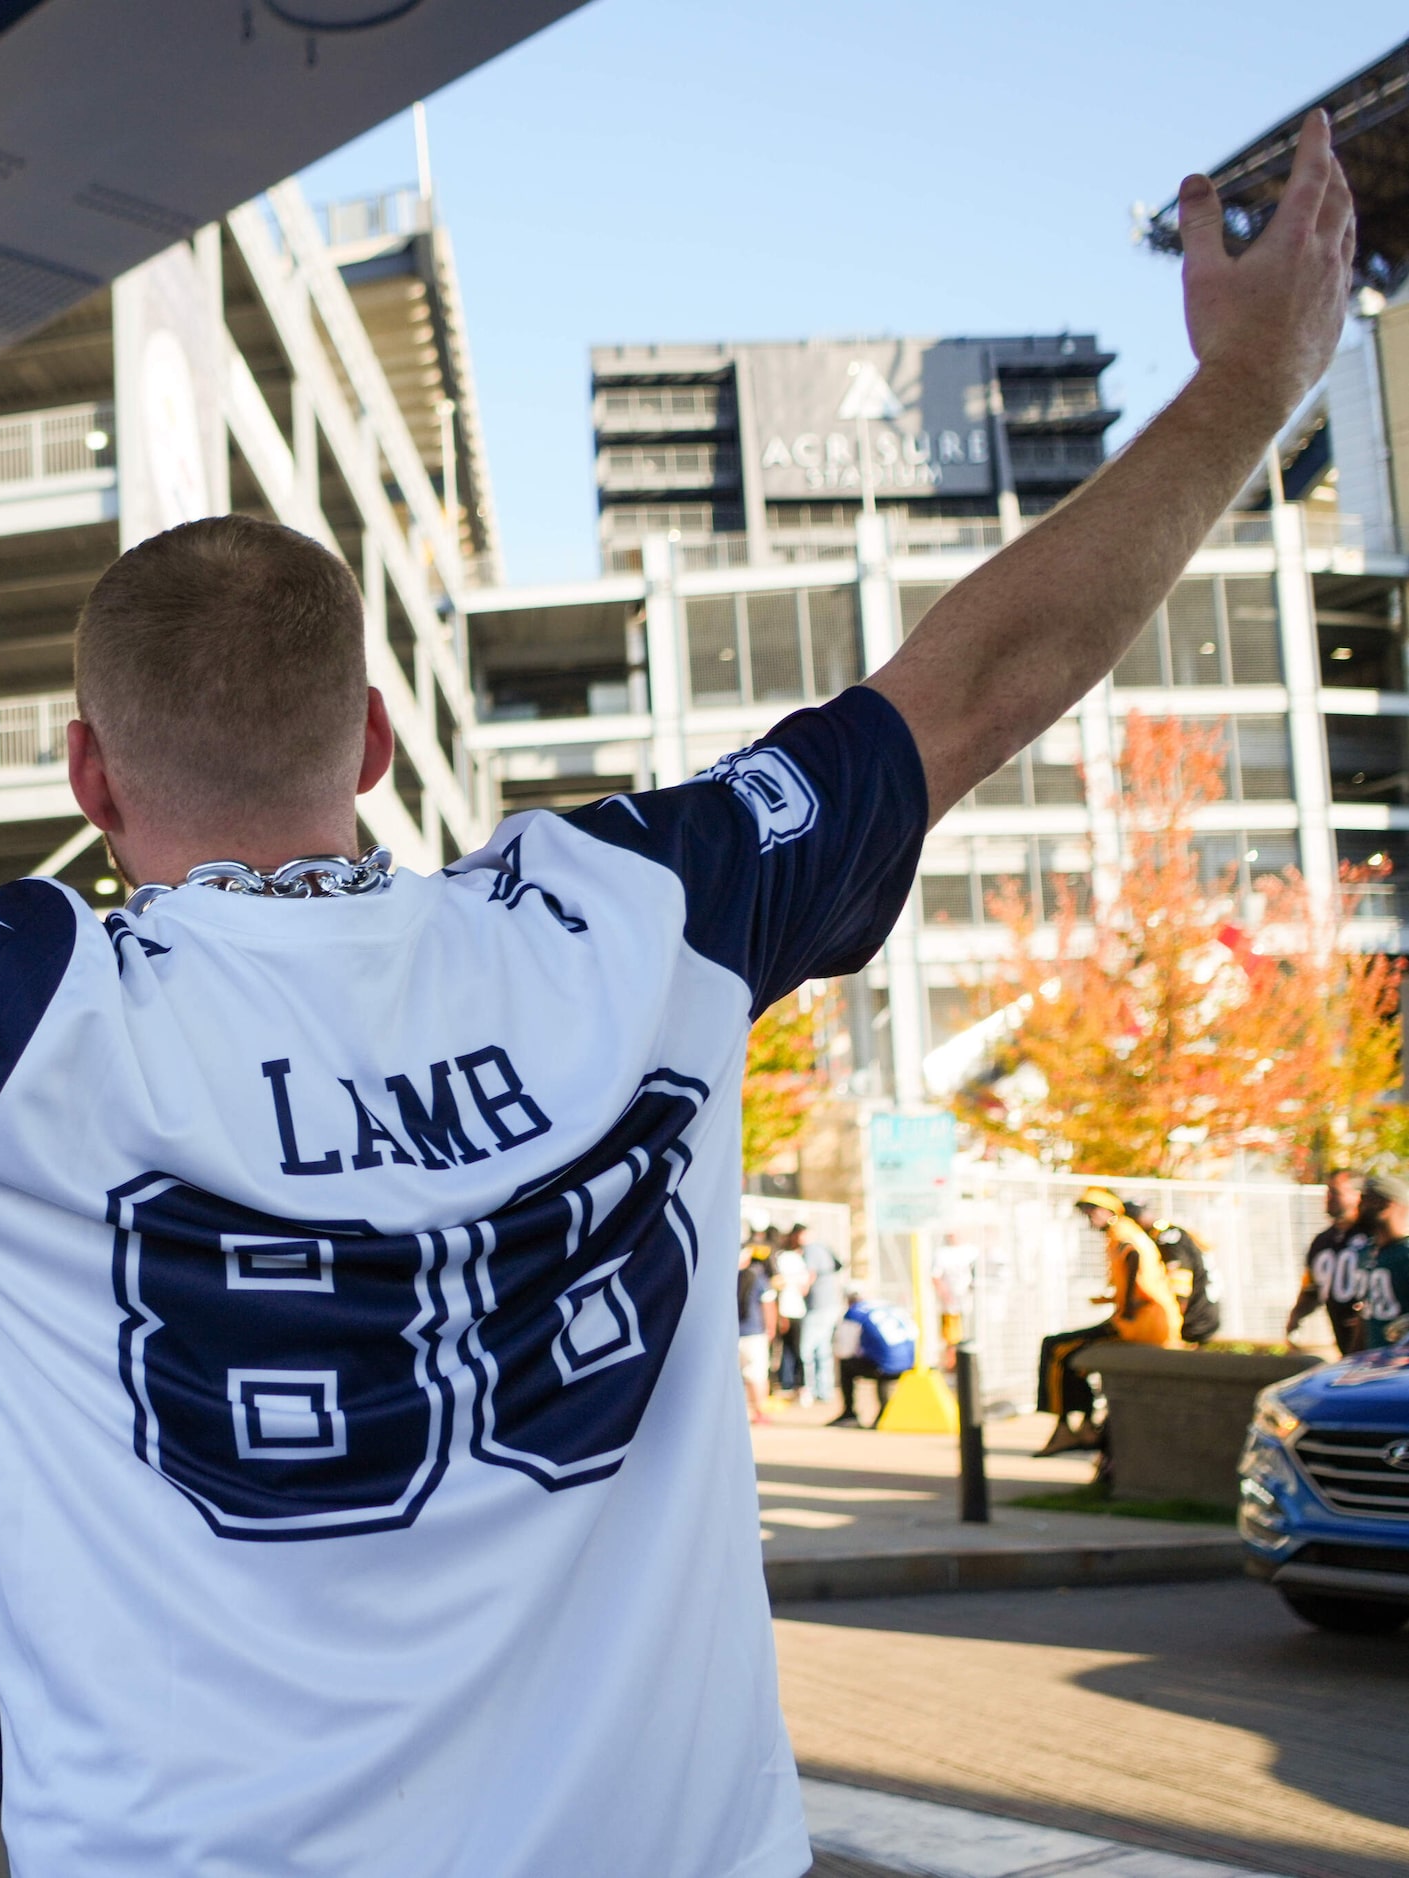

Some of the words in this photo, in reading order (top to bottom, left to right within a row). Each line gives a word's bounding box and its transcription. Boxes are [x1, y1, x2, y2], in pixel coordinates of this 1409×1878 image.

[762, 429, 989, 469] ACRSURE
[262, 1045, 553, 1175] LAMB
[105, 1067, 711, 1542] 88
[1312, 1248, 1359, 1303] 90
